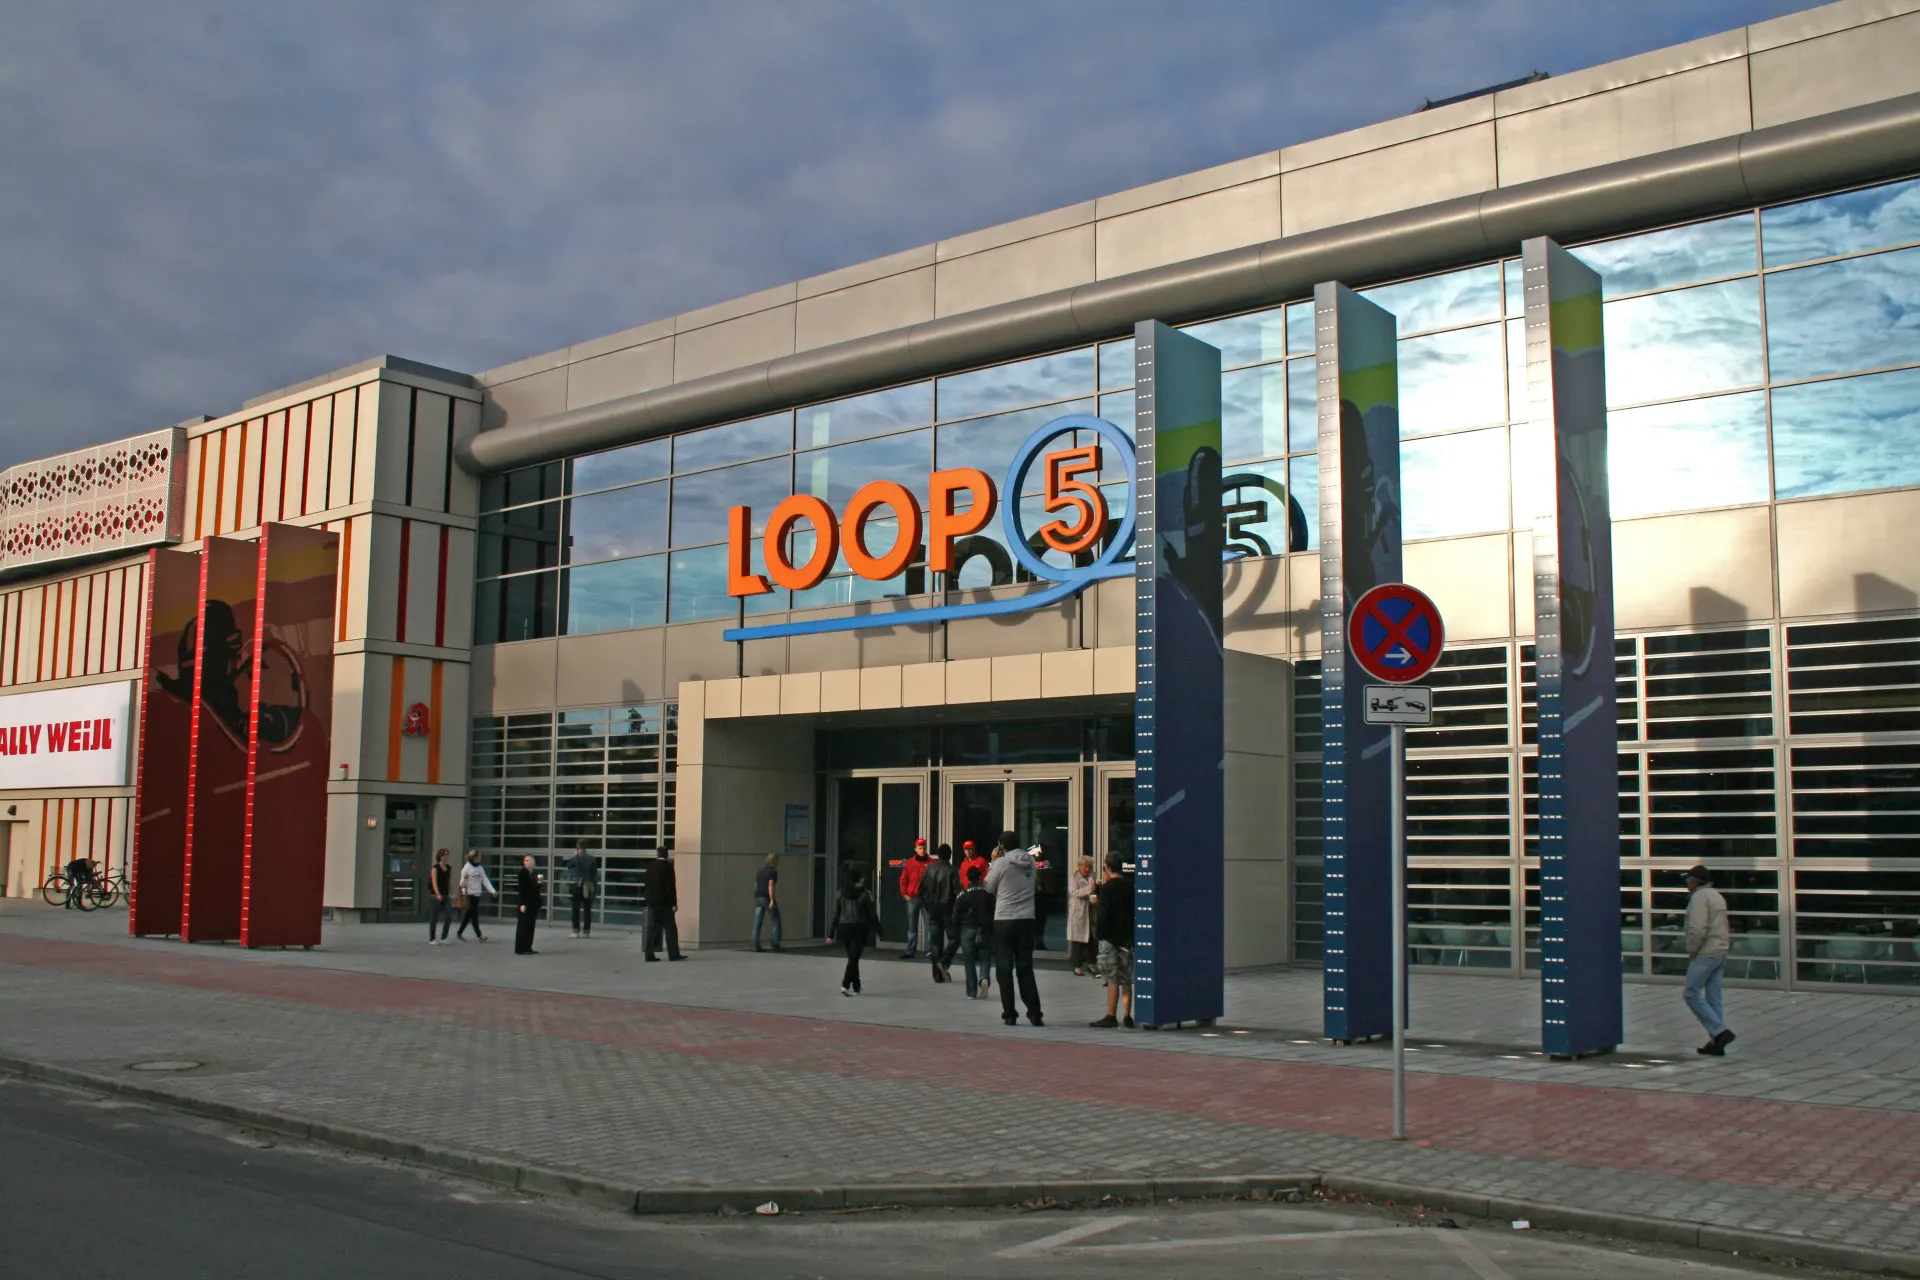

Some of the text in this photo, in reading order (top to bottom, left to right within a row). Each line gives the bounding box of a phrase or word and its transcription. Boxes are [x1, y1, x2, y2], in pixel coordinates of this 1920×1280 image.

[728, 445, 1110, 597] LOOP 5
[0, 724, 42, 756] ALLY
